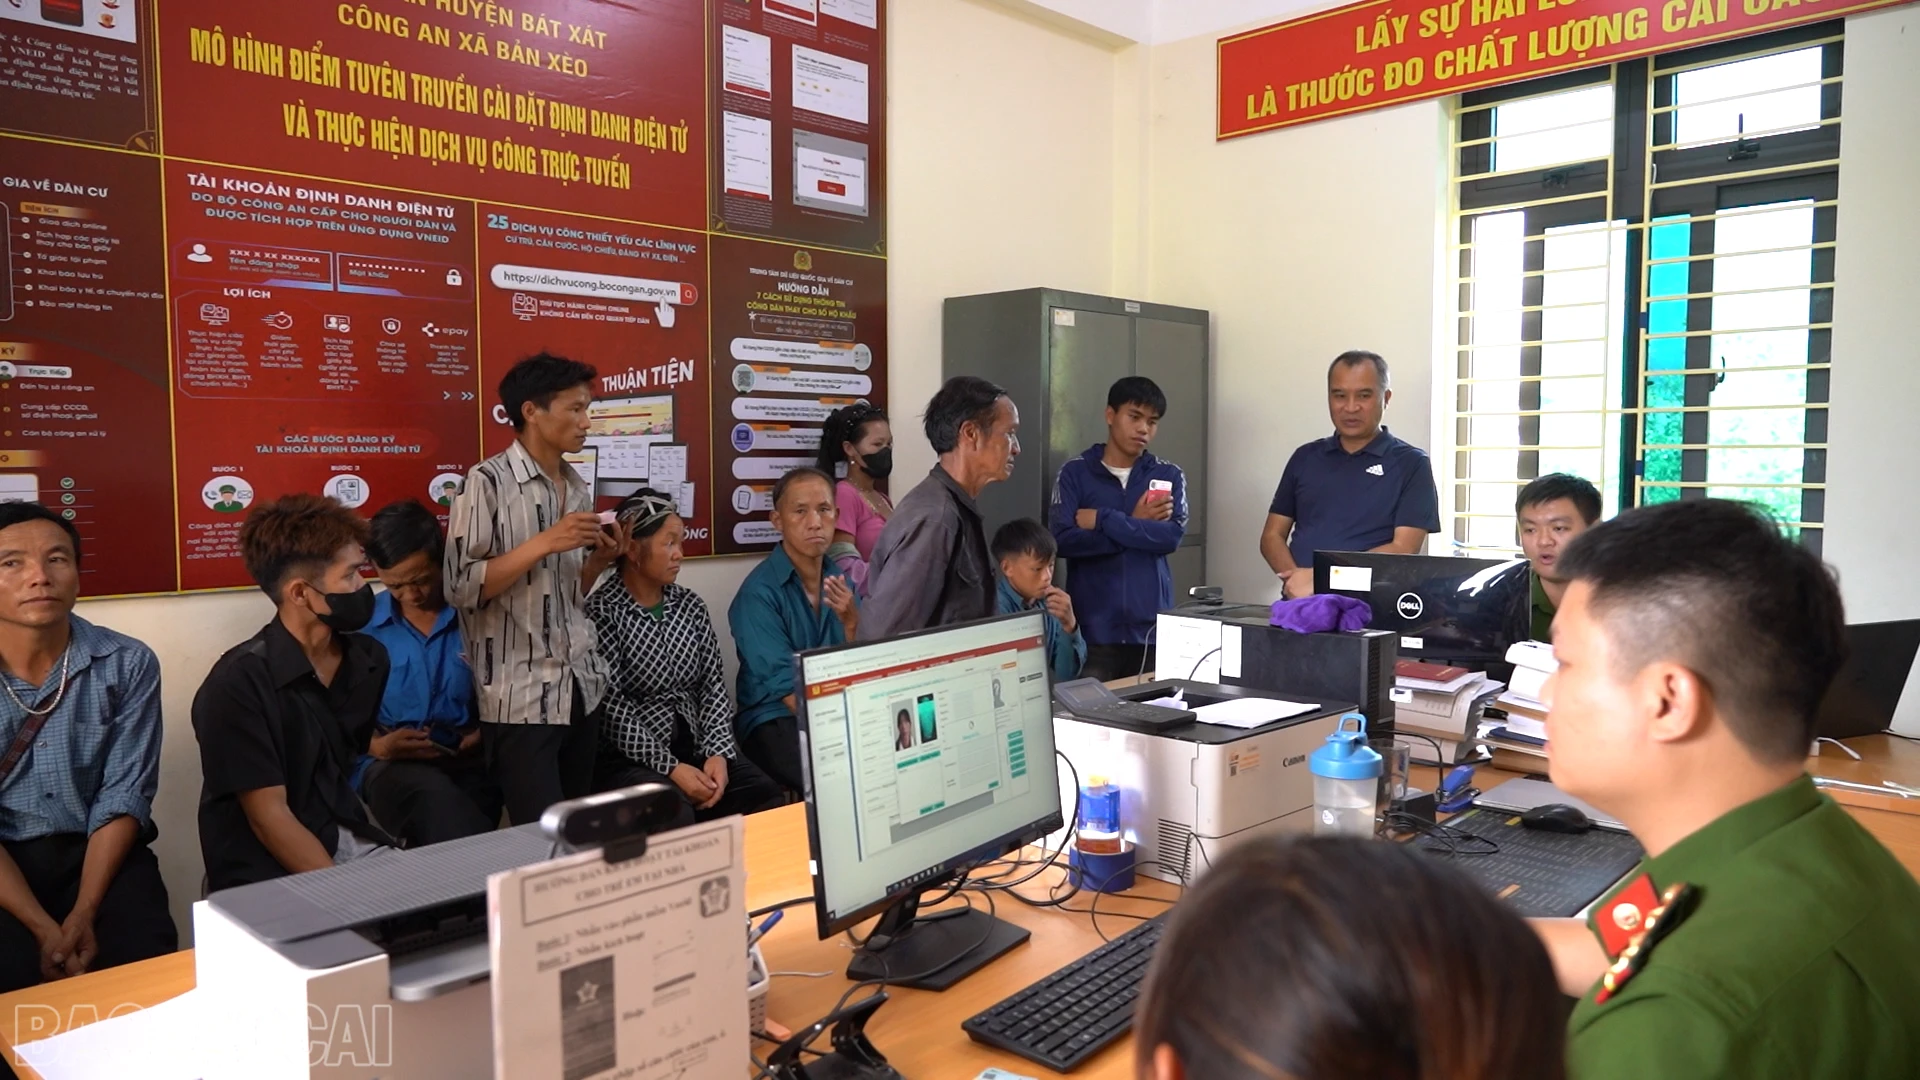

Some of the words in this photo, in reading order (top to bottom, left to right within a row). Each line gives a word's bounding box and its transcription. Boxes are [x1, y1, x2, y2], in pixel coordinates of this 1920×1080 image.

[338, 4, 409, 38] CÔNG
[418, 23, 450, 48] AN
[458, 32, 489, 56] XÃ
[496, 40, 540, 67] BẢN
[548, 52, 588, 78] XÈO
[522, 12, 562, 38] BÁT
[569, 24, 607, 50] XÁT
[1356, 8, 1409, 54] LẤY
[1418, 0, 1466, 38] SỰ
[1248, 85, 1278, 120] LÀ
[1286, 64, 1374, 111] THƯỚC
[1384, 58, 1424, 90] ĐO
[1435, 28, 1517, 80] CHẤT
[1529, 8, 1648, 61] LƯỢNG
[190, 26, 226, 66] MÔ
[232, 32, 284, 78] HÌNH
[289, 40, 341, 88] ĐIỂM
[346, 60, 406, 101] TUYÊN
[411, 73, 478, 114] TRUYỀN
[484, 84, 510, 120] CÀI
[515, 91, 546, 132] ĐẶT
[550, 100, 586, 138] ĐỊNH
[592, 109, 630, 143] DANH
[634, 116, 666, 154] ĐIỆN
[670, 119, 688, 154] TỬ
[283, 100, 310, 139] VÀ
[315, 109, 365, 152] THỰC
[371, 116, 414, 160] HIỆN
[420, 128, 460, 166] DỊCH
[466, 136, 487, 174] VỤ
[493, 136, 536, 174] CÔNG
[541, 148, 580, 186] TRỰC
[584, 152, 630, 190] TUYẾN
[3, 177, 30, 188] GIA
[33, 179, 50, 190] VỀ
[54, 183, 84, 195] DÂN
[88, 188, 108, 198] CƯ
[187, 172, 216, 188] TÀI
[223, 178, 290, 198] KHOẢN
[296, 188, 339, 204] ĐỊNH
[345, 194, 392, 211] DANH
[396, 202, 432, 216] ĐIỆN
[436, 206, 454, 218] TỬ
[192, 192, 213, 202] DO
[218, 195, 237, 206] BỘ
[242, 198, 284, 210] CÔNG
[288, 204, 306, 214] AN
[340, 210, 369, 221] CHO
[372, 214, 412, 226] NGƯỜI
[416, 219, 440, 230] DÂN
[206, 208, 247, 220] ĐƯỢC
[250, 212, 281, 224] TÍCH
[285, 216, 314, 228] HỢP
[316, 220, 345, 232] TRÊN
[349, 224, 376, 235] ỨNG
[380, 228, 414, 238] DỤNG
[416, 232, 450, 244] VNEID
[487, 214, 509, 230] 25
[512, 222, 536, 234] DỊCH
[540, 226, 554, 236] VỤ
[556, 228, 584, 240] CÔNG
[586, 230, 612, 243] THIẾT
[614, 234, 632, 245] YẾU
[635, 237, 654, 248] CÁC
[656, 240, 676, 251] LĨNH
[678, 243, 696, 254] VỰC
[224, 288, 244, 298] LỢI
[248, 288, 271, 298] ÍCH
[503, 271, 676, 298] https://dichvucong.bocongan.gov.vn
[778, 282, 809, 294] HƯỚNG
[442, 327, 468, 336] epay
[602, 367, 647, 394] THUẬN
[651, 357, 694, 389] TIỆN
[256, 445, 272, 453] TÀI
[277, 445, 317, 454] KHOẢN
[321, 446, 348, 454] ĐỊNH
[384, 446, 406, 454] ĐIỆN
[284, 434, 308, 443] CÁC
[312, 434, 343, 443] BƯỚC
[347, 436, 378, 444] ĐĂNG
[1400, 601, 1420, 610] DELL
[1282, 754, 1306, 768] Canon
